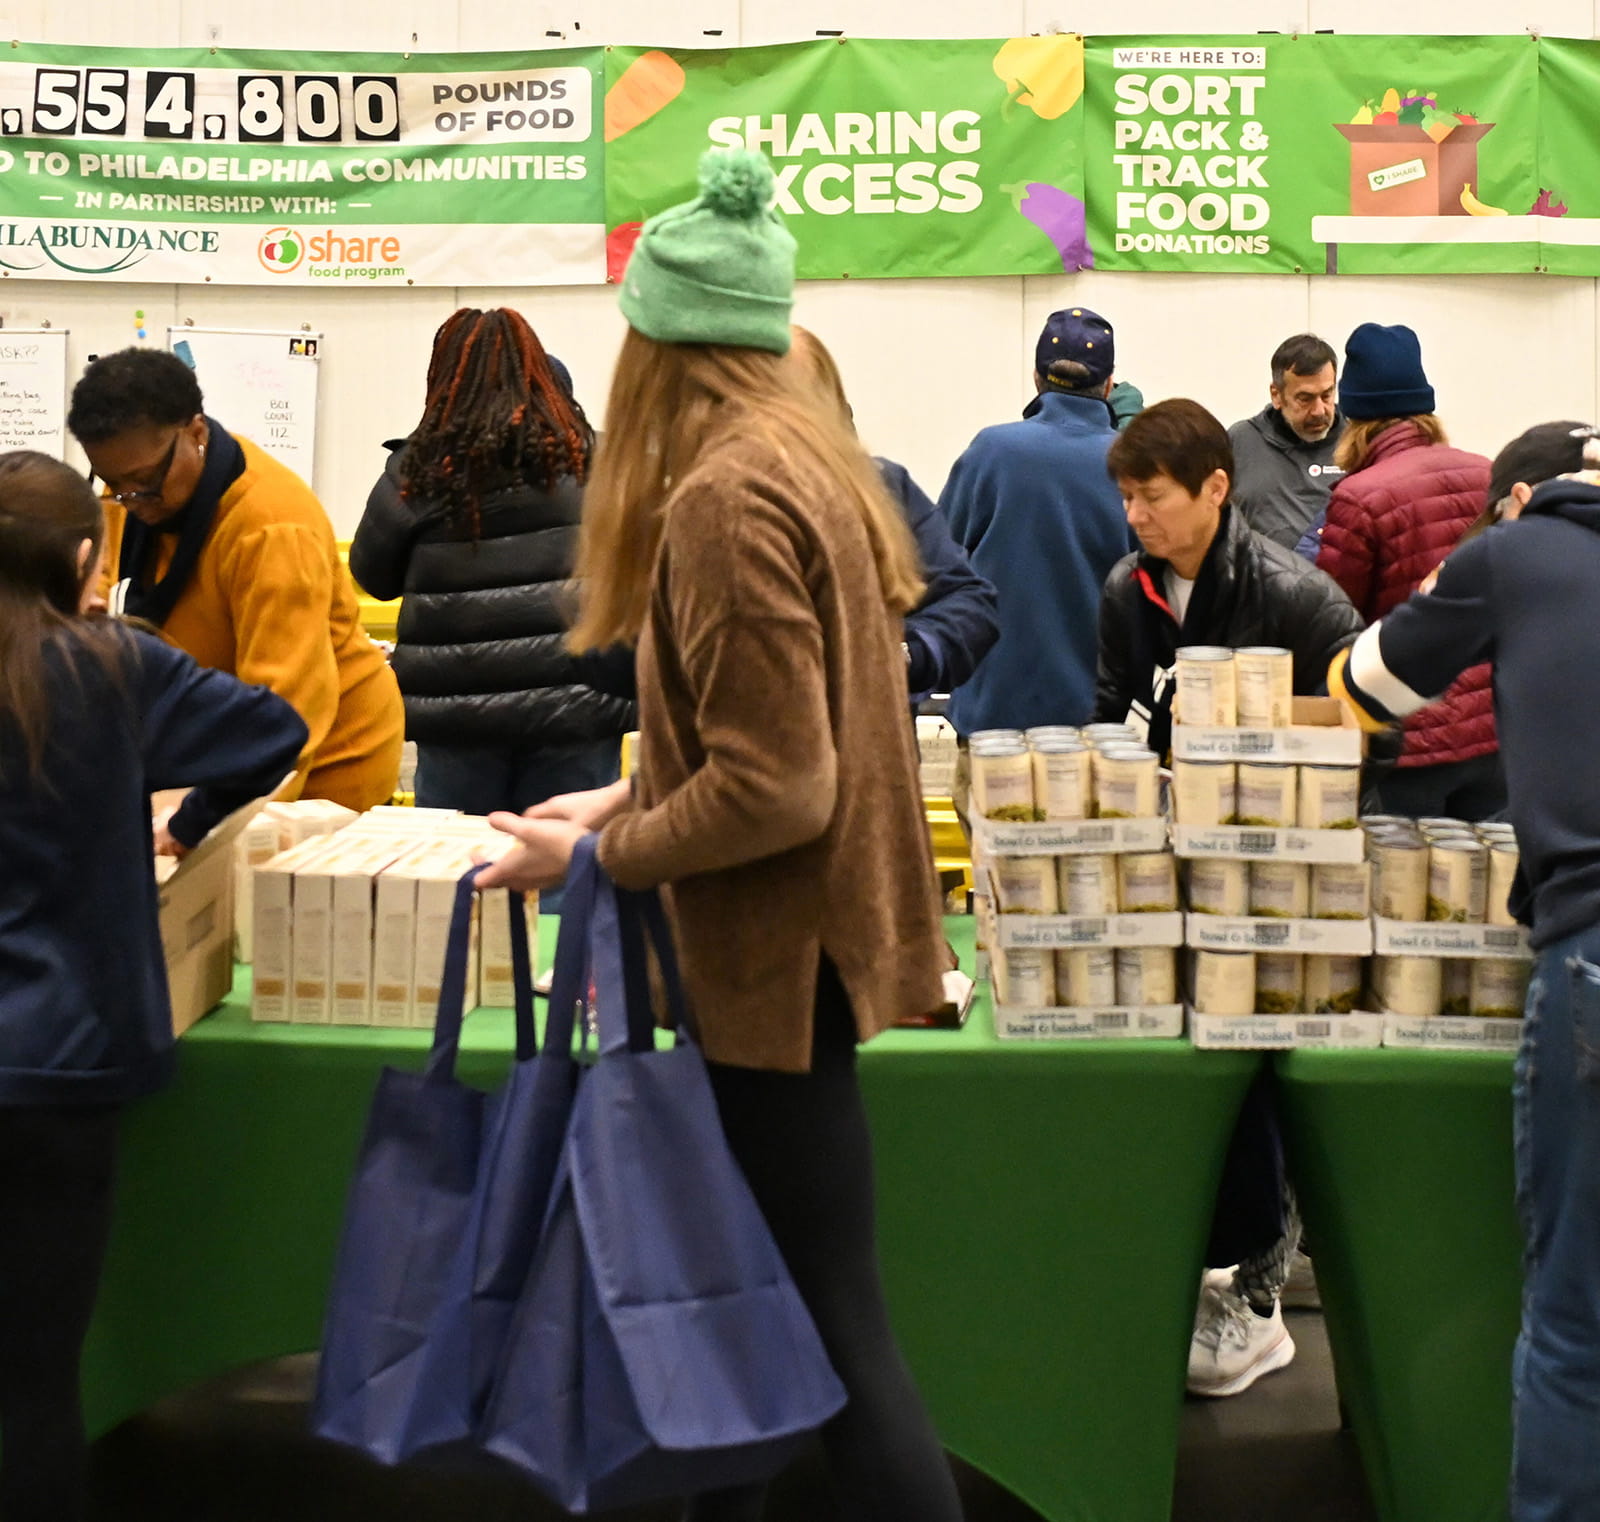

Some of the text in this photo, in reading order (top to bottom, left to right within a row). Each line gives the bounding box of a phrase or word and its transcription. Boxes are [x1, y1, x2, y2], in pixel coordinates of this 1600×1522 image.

[1118, 51, 1261, 64] WE'RE HERE TO:
[432, 79, 567, 105] POUNDS
[1114, 73, 1266, 116] SORT
[434, 108, 575, 132] OF FOOD
[707, 109, 982, 157] SHARING
[1115, 120, 1270, 151] PACK &
[24, 151, 71, 176] TO
[78, 153, 334, 183] PHILADELPHIA
[342, 155, 588, 183] COMMUNITIES
[1113, 154, 1270, 188] TRACK
[75, 191, 337, 214] IN PARTNERSHIP WITH:
[770, 160, 984, 216] XCESS
[1116, 191, 1271, 232] FOOD
[0, 224, 220, 273] ILABUNDANCE
[308, 230, 401, 263] share
[1115, 233, 1271, 255] DONATIONS
[309, 266, 405, 280] food program
